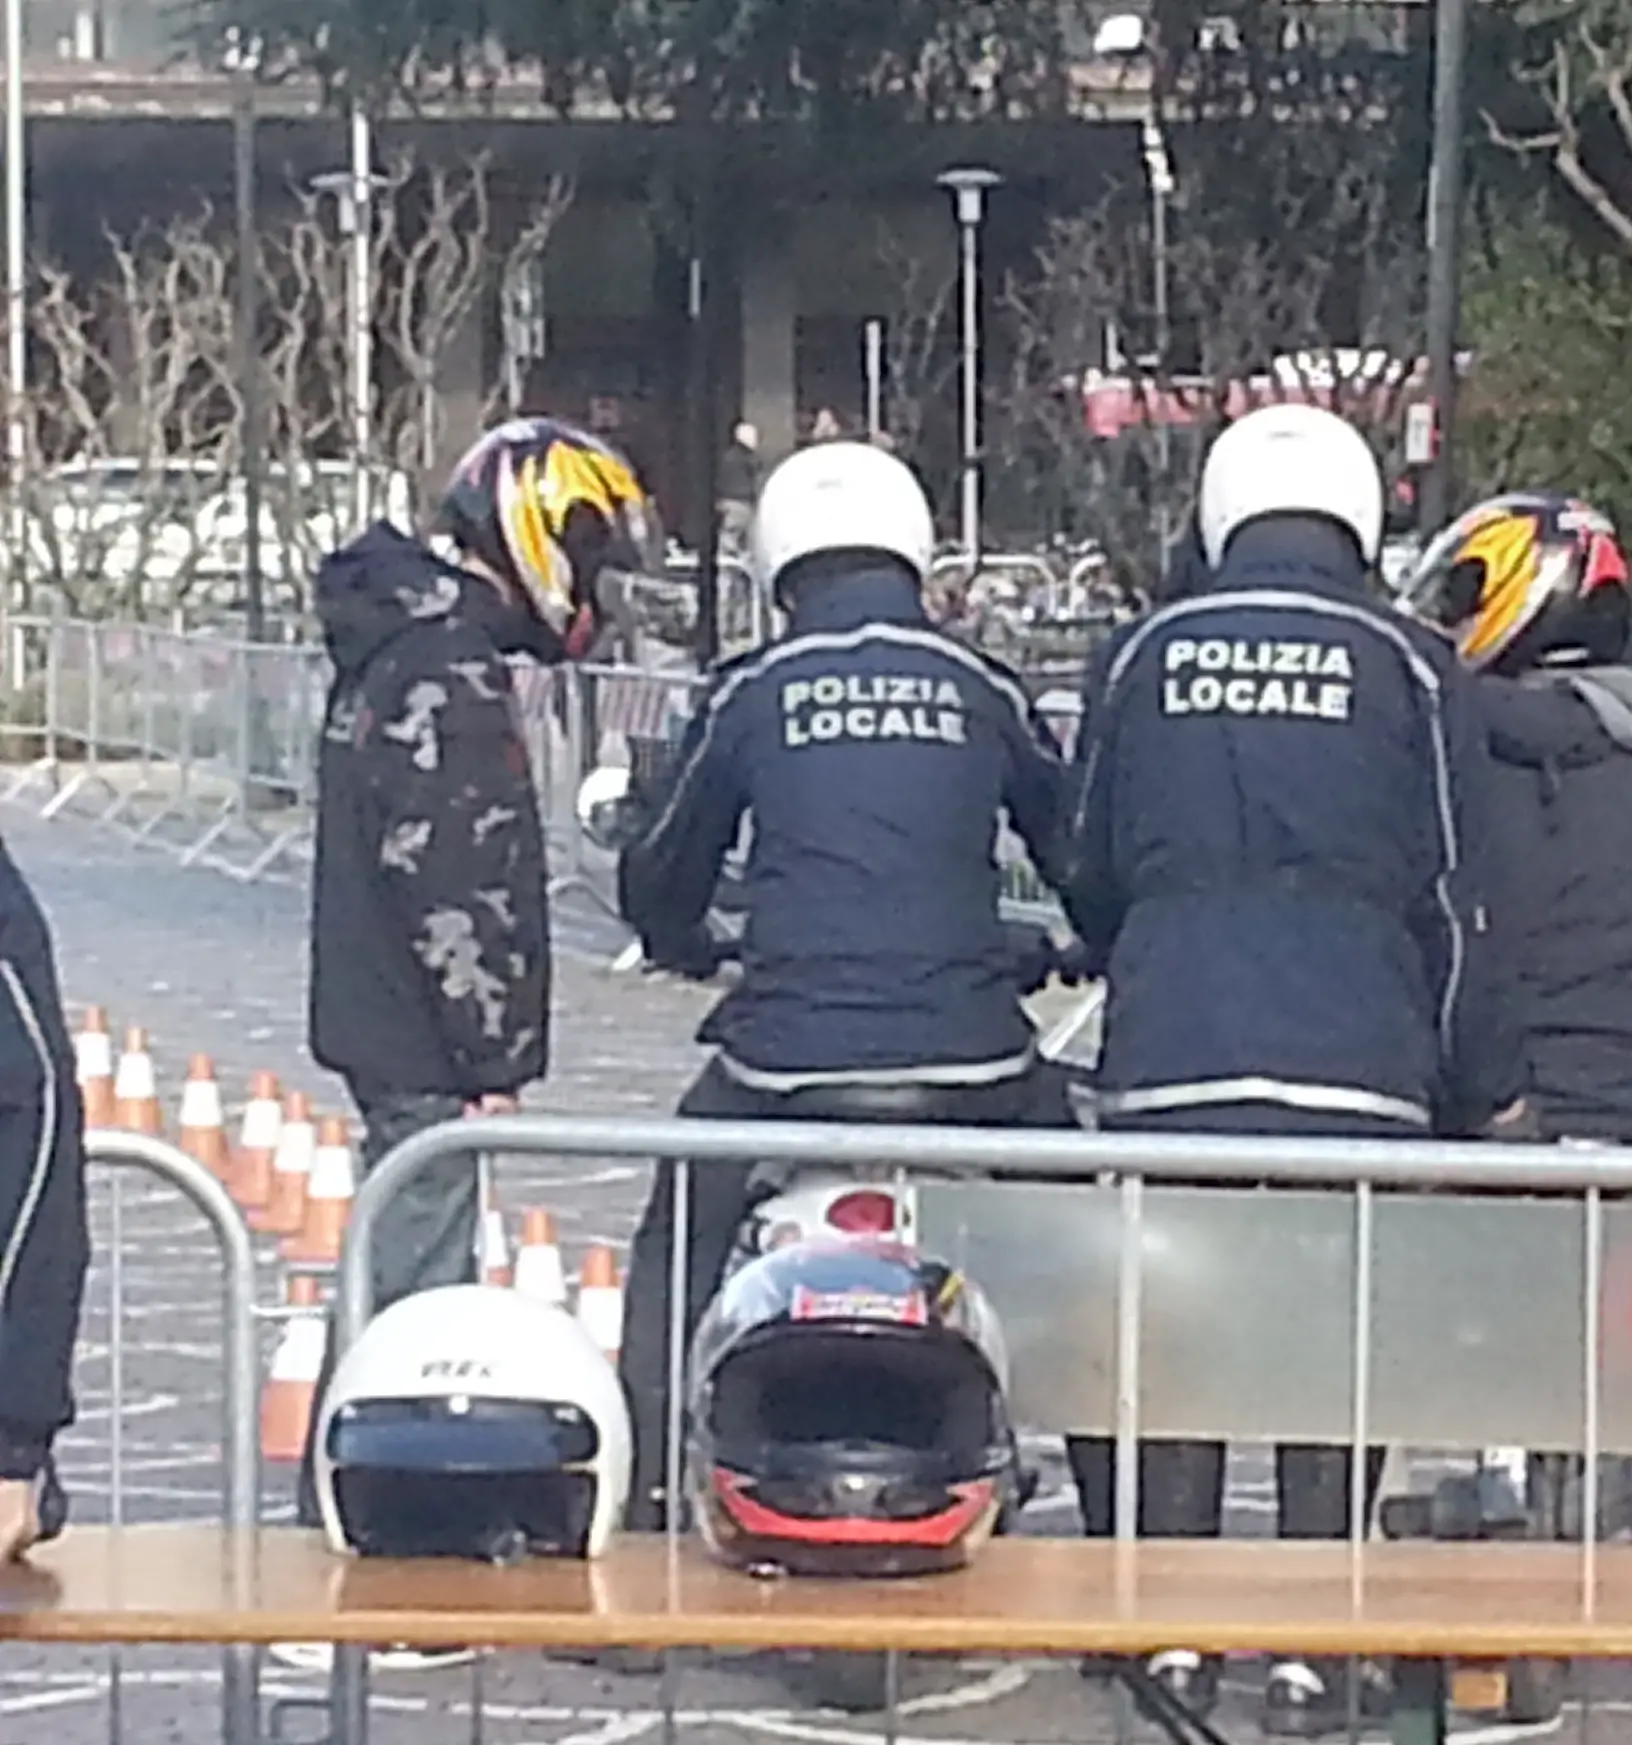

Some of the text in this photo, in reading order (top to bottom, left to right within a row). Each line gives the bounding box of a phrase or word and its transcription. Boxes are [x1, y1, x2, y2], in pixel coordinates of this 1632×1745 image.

[1166, 639, 1353, 676] POLIZIA
[784, 676, 963, 712] POLIZIA
[1164, 677, 1350, 719] LOCALE
[785, 707, 967, 746] LOCALE
